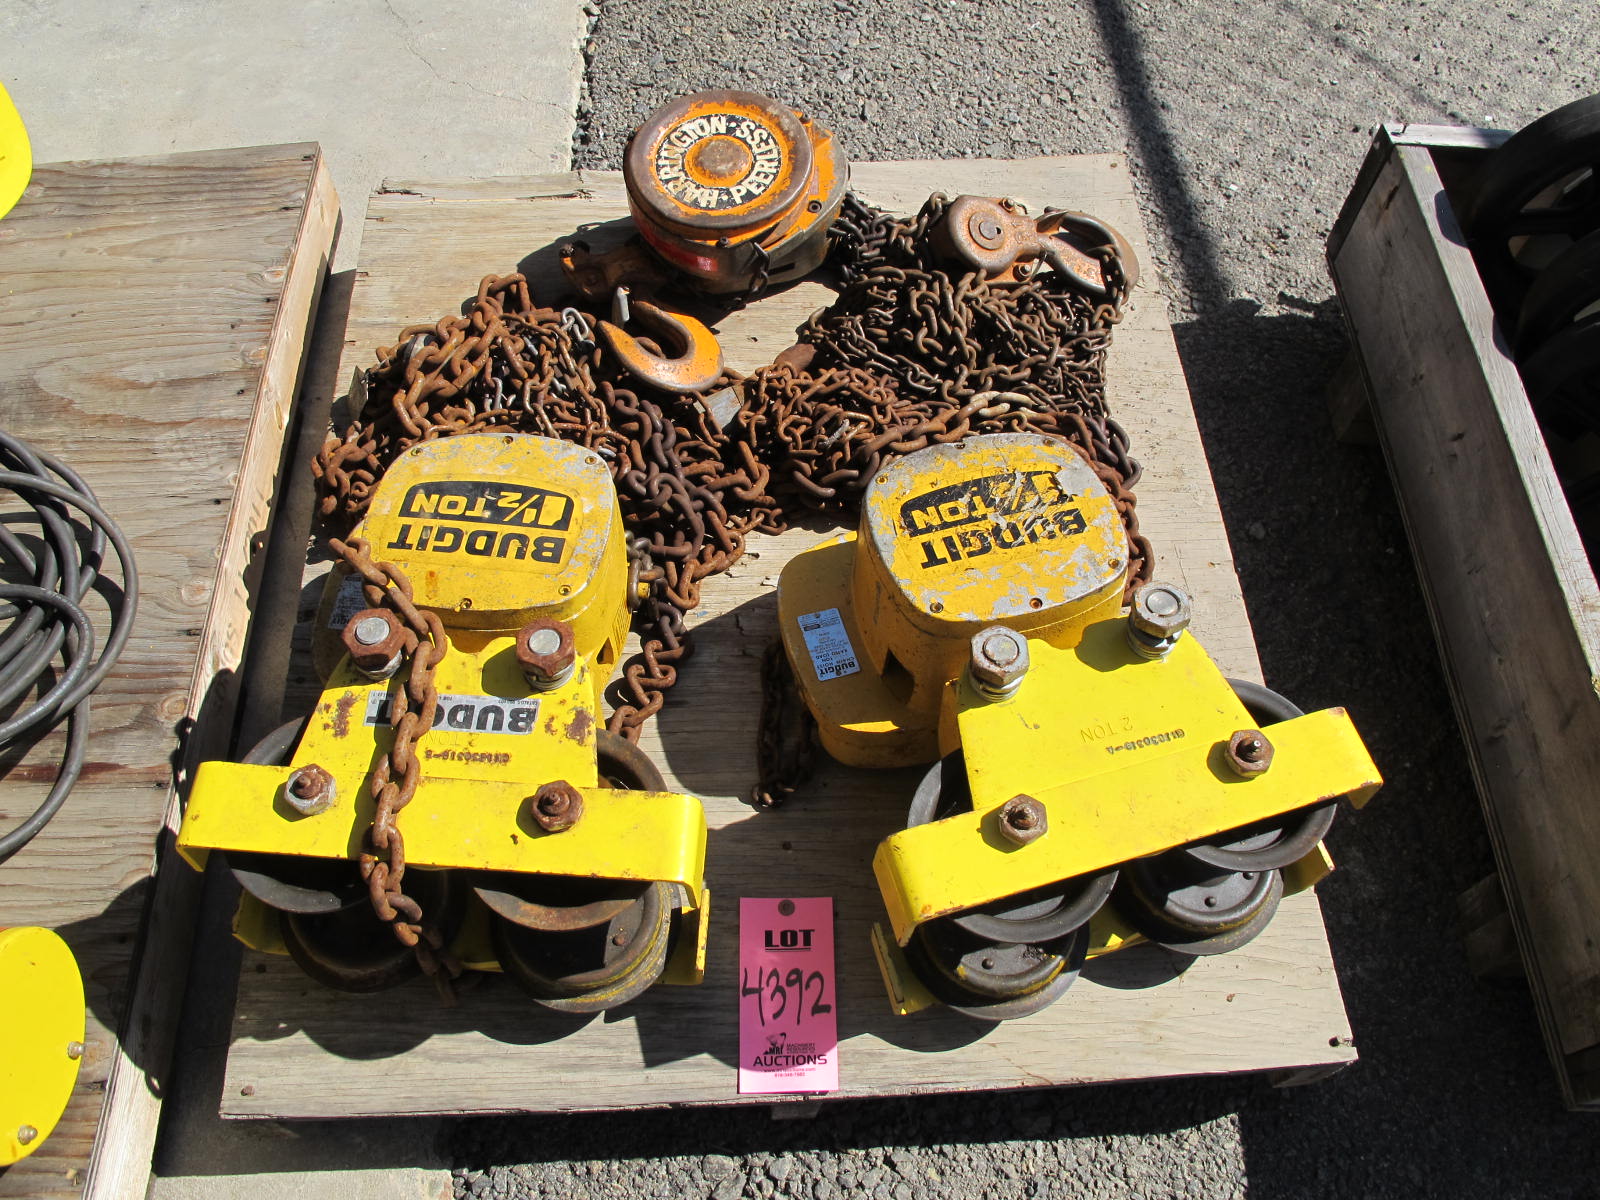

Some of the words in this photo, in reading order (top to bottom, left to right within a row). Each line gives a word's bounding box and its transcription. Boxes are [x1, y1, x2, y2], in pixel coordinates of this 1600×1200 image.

[656, 116, 728, 208] HARRINGTON
[729, 121, 779, 205] PEERLESS
[411, 494, 487, 518] TON
[912, 498, 994, 529] TON
[387, 524, 567, 564] BUDGIT
[921, 508, 1088, 570] BUDGIT
[818, 661, 856, 676] BUDGIT
[366, 699, 536, 733] BUDT
[1119, 716, 1133, 732] 2
[1079, 722, 1116, 744] TON
[764, 928, 816, 948] LOT
[742, 965, 832, 1027] 4392
[753, 1054, 828, 1067] AUCTIONS
[768, 1044, 784, 1055] MRI
